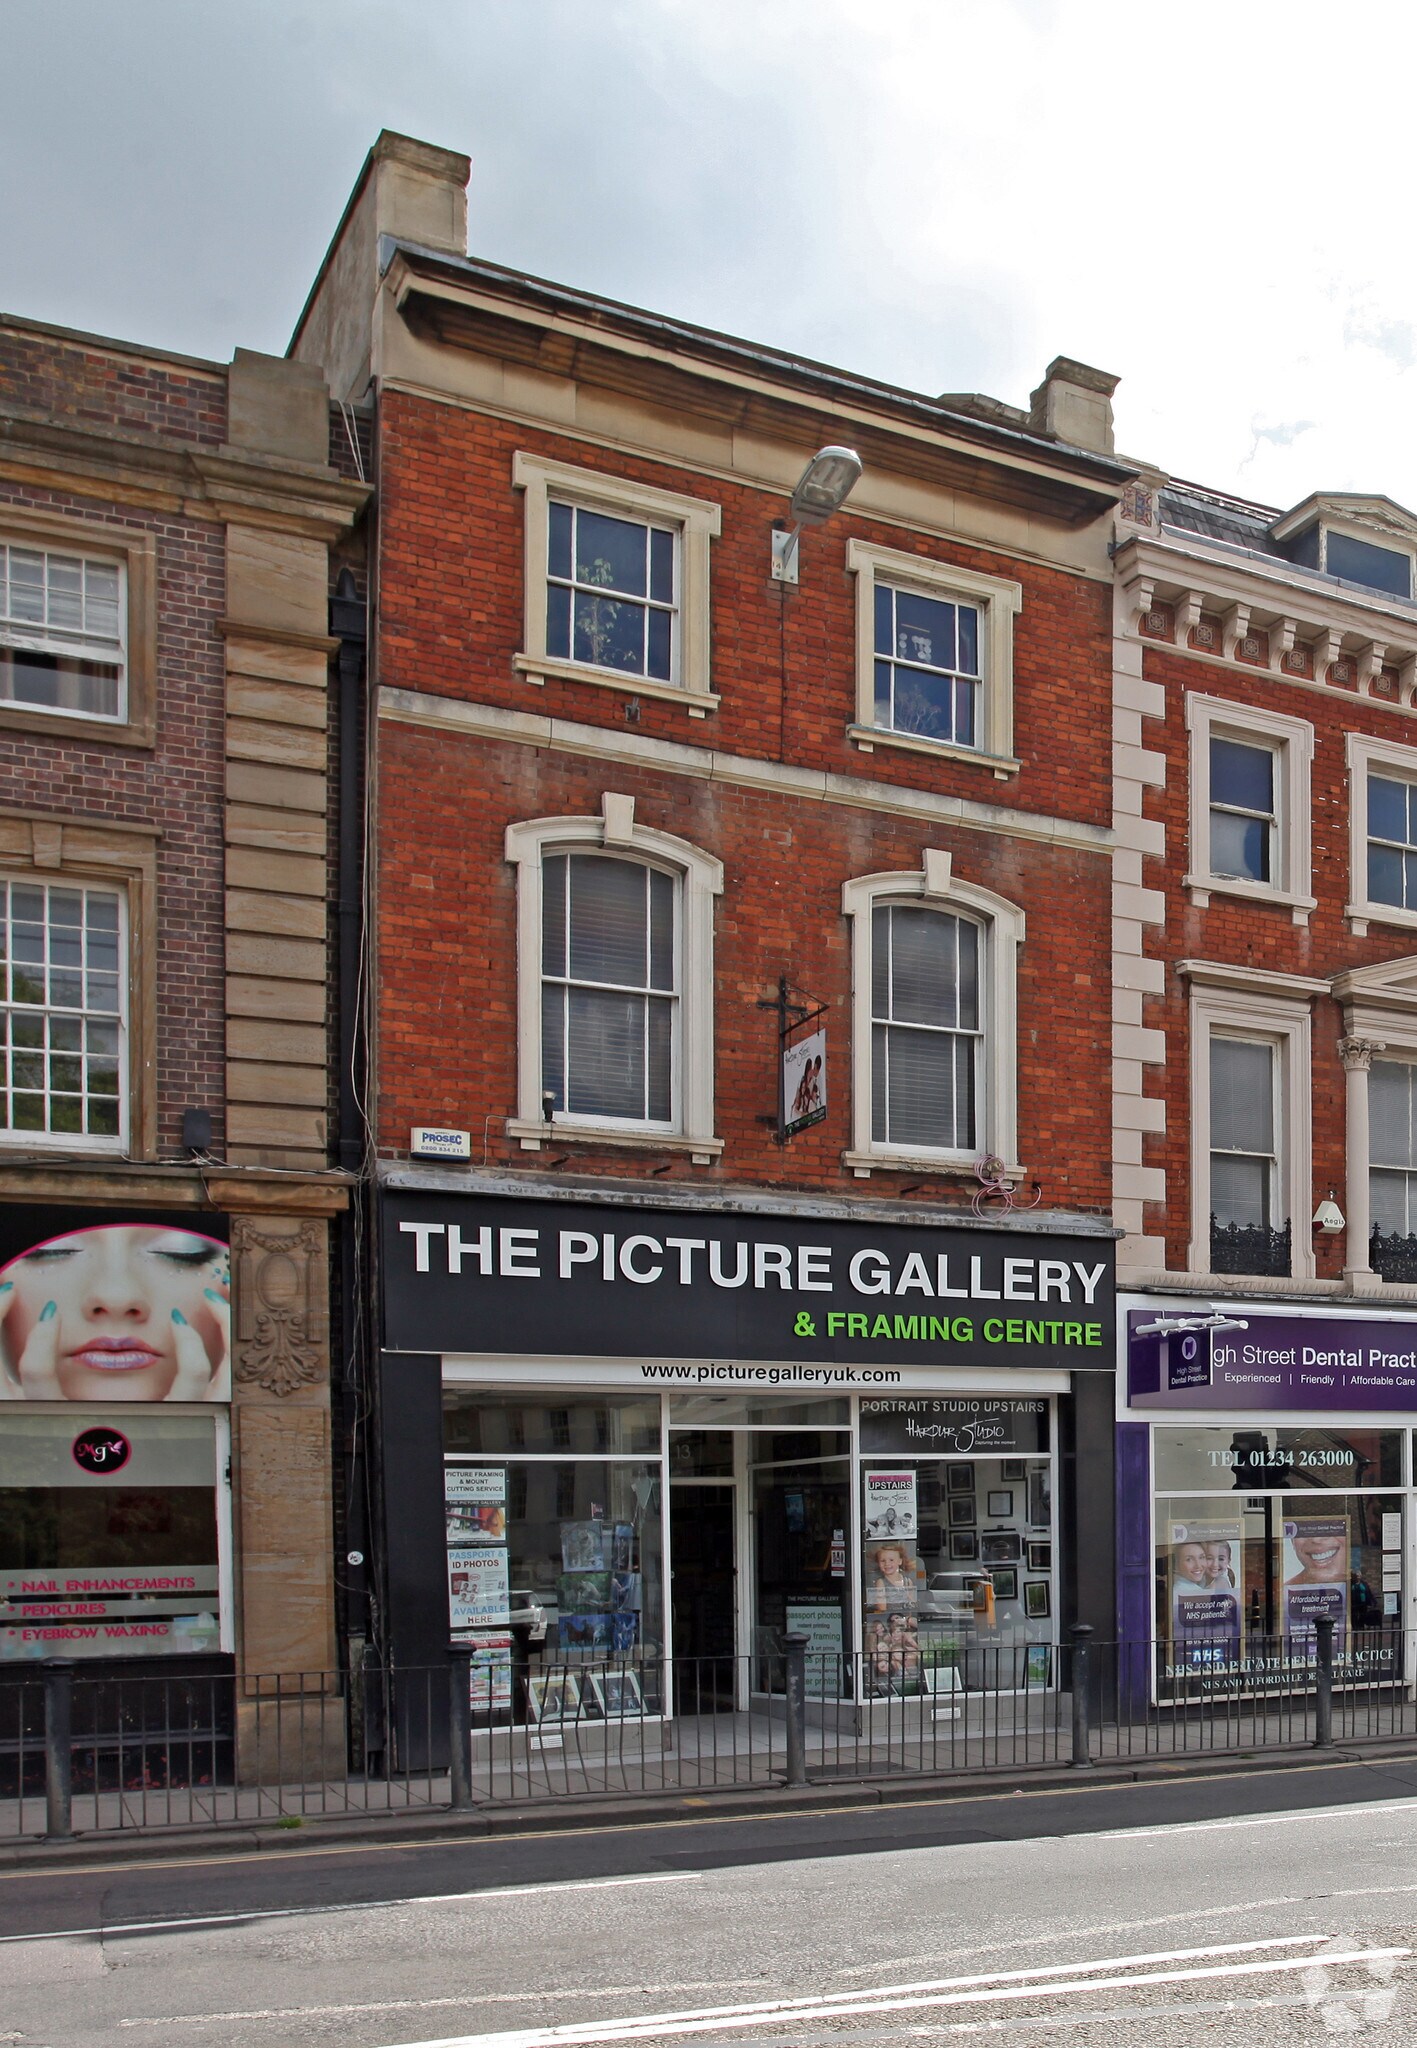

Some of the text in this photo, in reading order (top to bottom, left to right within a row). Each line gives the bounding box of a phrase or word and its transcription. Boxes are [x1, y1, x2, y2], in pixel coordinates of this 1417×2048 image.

[422, 1132, 462, 1145] PROSEC
[400, 1221, 1107, 1304] THE PICTURE GALLERY
[794, 1312, 1102, 1346] & FRAMING CENTRE
[1243, 1345, 1296, 1365] Street
[1302, 1347, 1362, 1366] Dental
[1369, 1349, 1417, 1368] Pract
[641, 1363, 901, 1384] www.picturegalleryuk.com
[1224, 1373, 1416, 1386] Experienced Friendly Affordable Care
[1171, 1376, 1187, 1385] Dental
[861, 1401, 1045, 1413] PORTRAIT STUDIO UPSTAIRS
[676, 1444, 691, 1460] 13
[1207, 1450, 1354, 1467] TEL 01234 263000
[869, 1481, 912, 1490] UPSTAIRS
[449, 1551, 496, 1559] PASSPORT
[464, 1560, 500, 1568] PHOTOS
[21, 1577, 195, 1592] NAIL ENHANCEMENTS
[1195, 1601, 1215, 1609] accept
[1290, 1594, 1340, 1604] Affordable private
[21, 1603, 107, 1616] PEDICURES
[453, 1605, 506, 1615] AVAILABLE
[1301, 1604, 1330, 1613] treatment
[468, 1615, 493, 1624] HERE
[786, 1610, 842, 1620] passport photos
[1186, 1612, 1200, 1620] NHS
[22, 1624, 169, 1640] EYEBROW WAXING
[813, 1632, 840, 1641] framing
[1193, 1649, 1222, 1662] NHS
[1165, 1663, 1193, 1677] NHS
[1282, 1654, 1317, 1667] DENT
[1337, 1649, 1394, 1662] PRACTICE
[1222, 1679, 1242, 1688] AND
